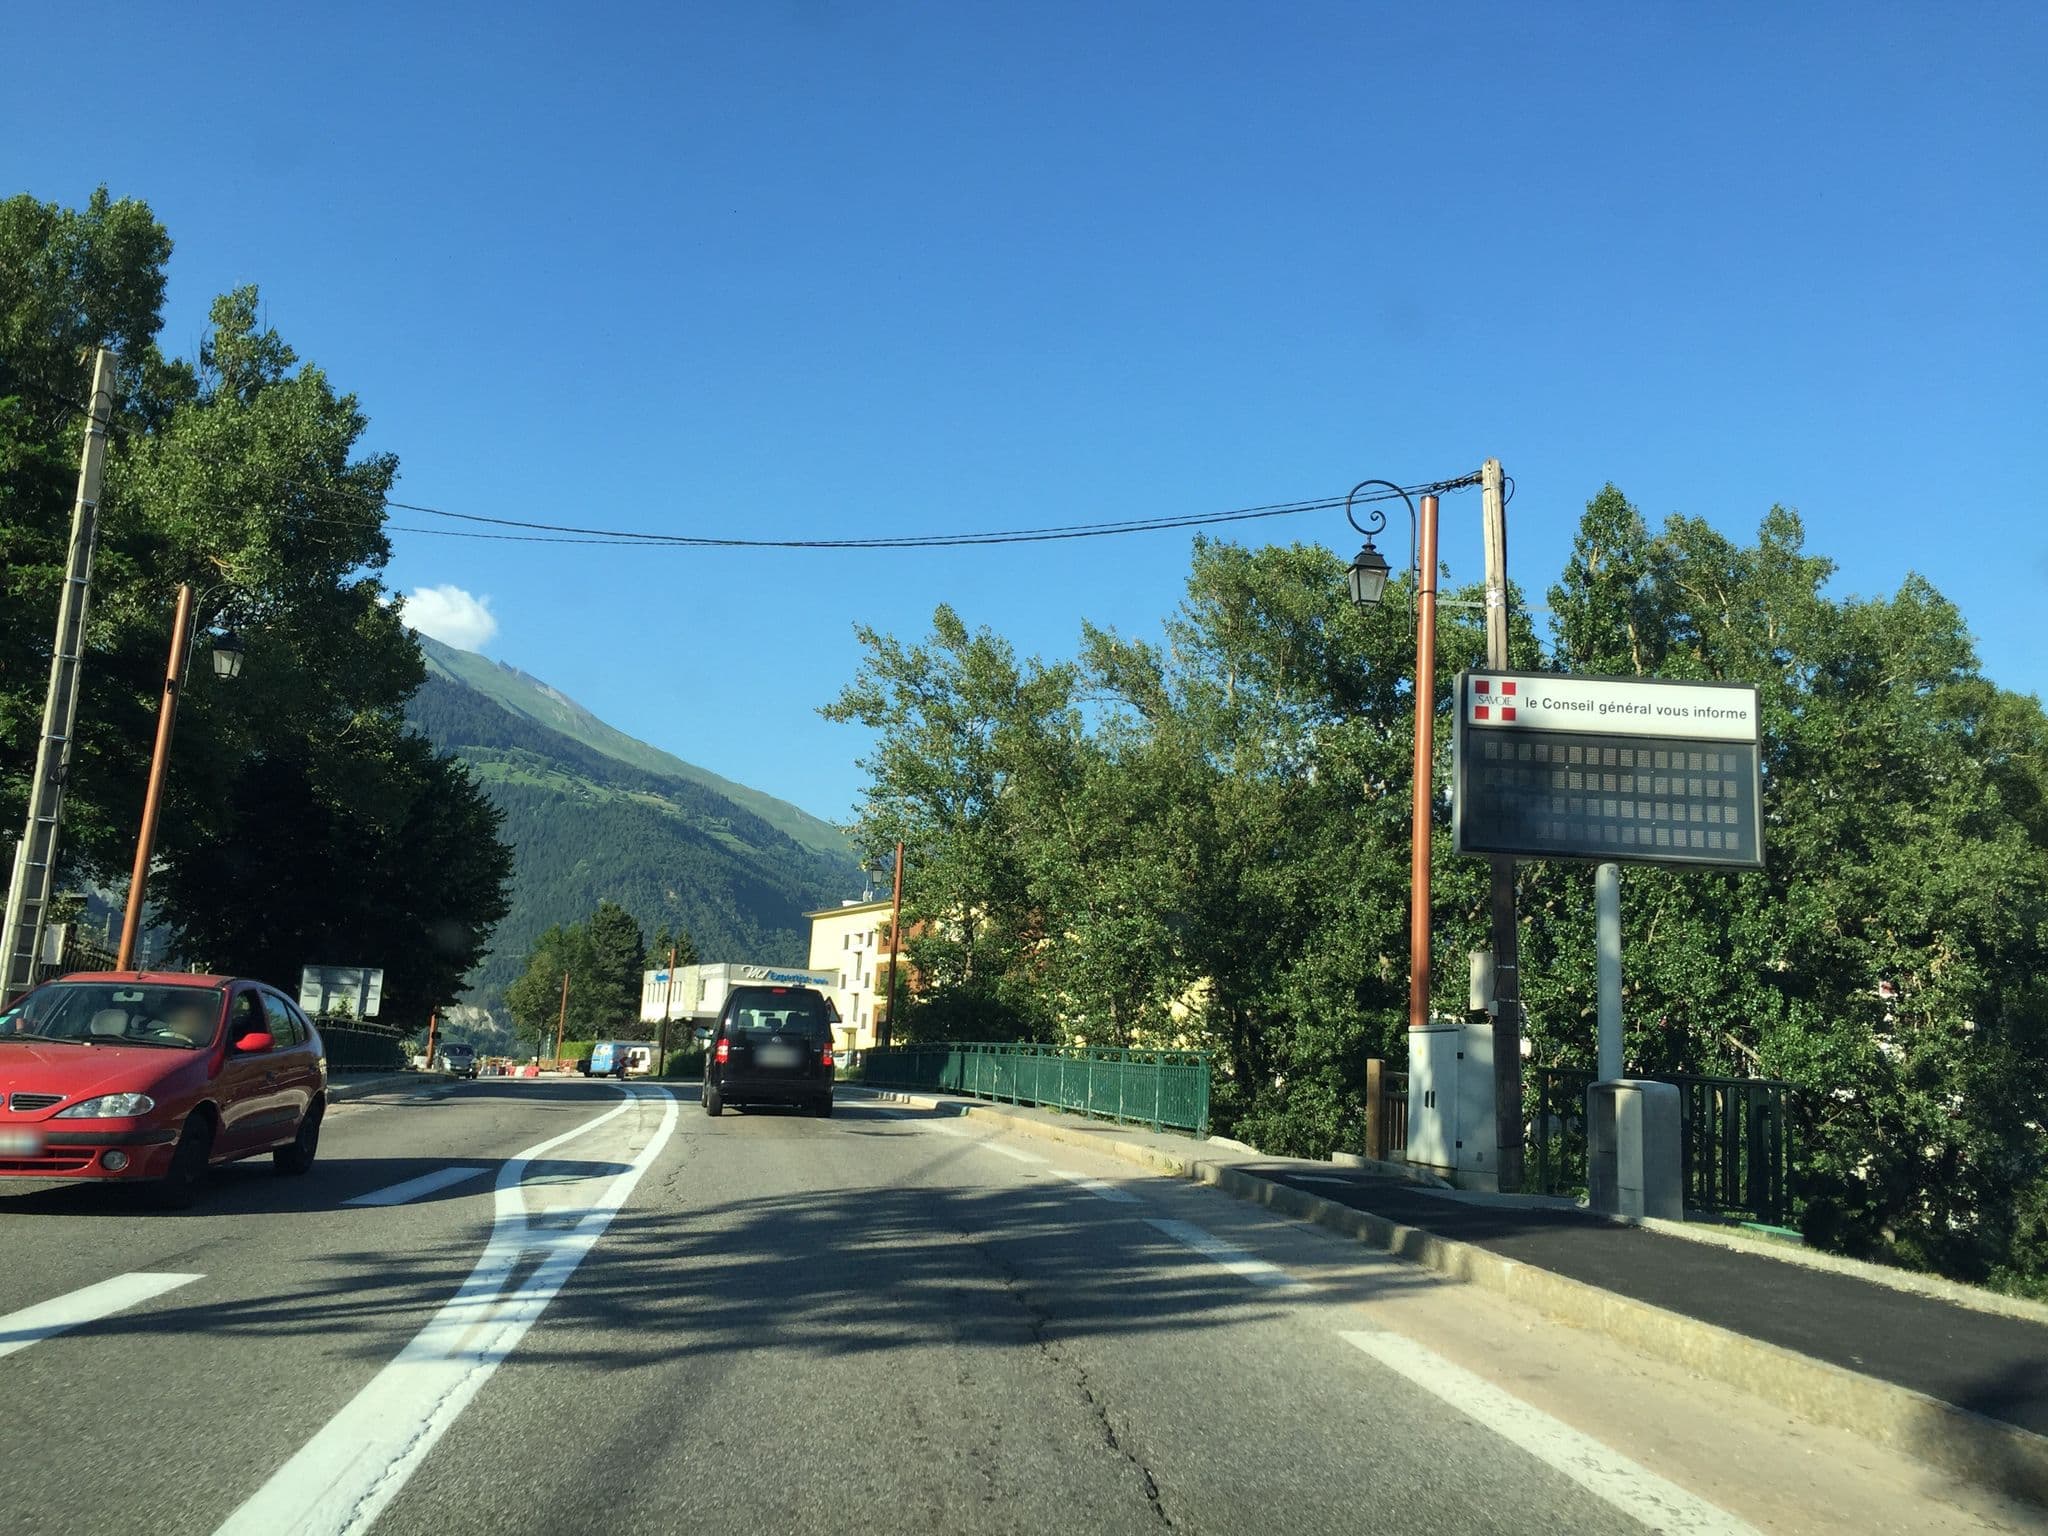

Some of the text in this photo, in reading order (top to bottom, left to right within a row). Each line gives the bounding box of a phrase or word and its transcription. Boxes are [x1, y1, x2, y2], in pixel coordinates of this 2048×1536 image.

[1478, 695, 1512, 706] SAVOIE
[1525, 697, 1747, 720] le Conseil général vous informe
